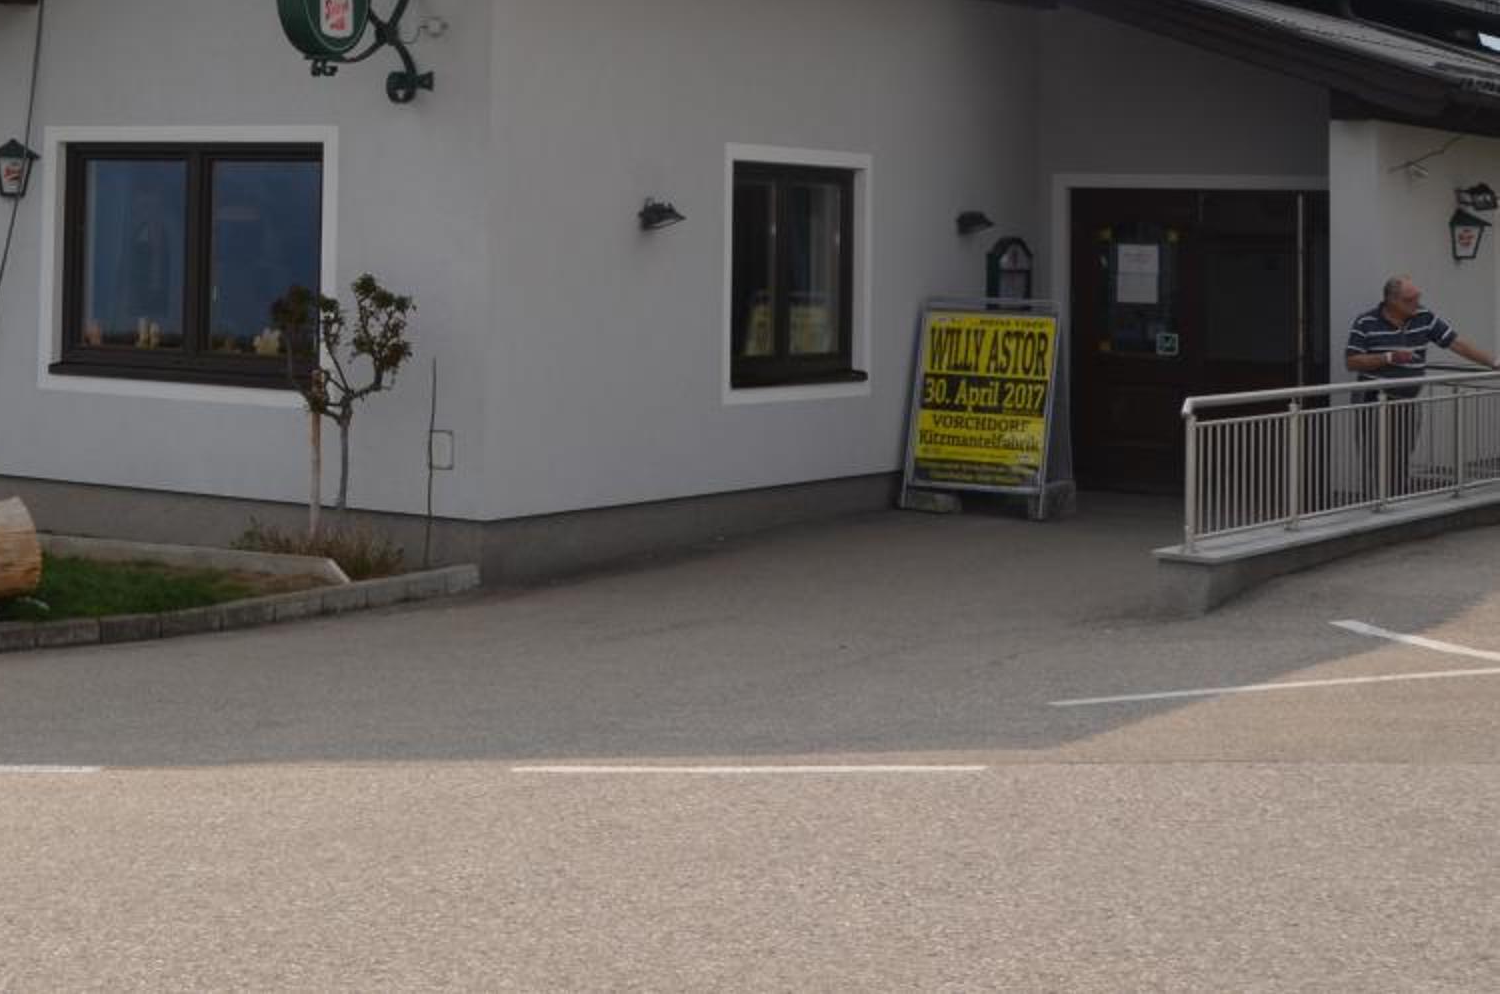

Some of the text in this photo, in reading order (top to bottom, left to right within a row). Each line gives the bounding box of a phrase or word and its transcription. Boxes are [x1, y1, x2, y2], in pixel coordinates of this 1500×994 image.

[930, 327, 1049, 377] WILLY ASTOR
[924, 377, 1045, 411] 30. April 2017
[932, 414, 1030, 433] VORCHDORF
